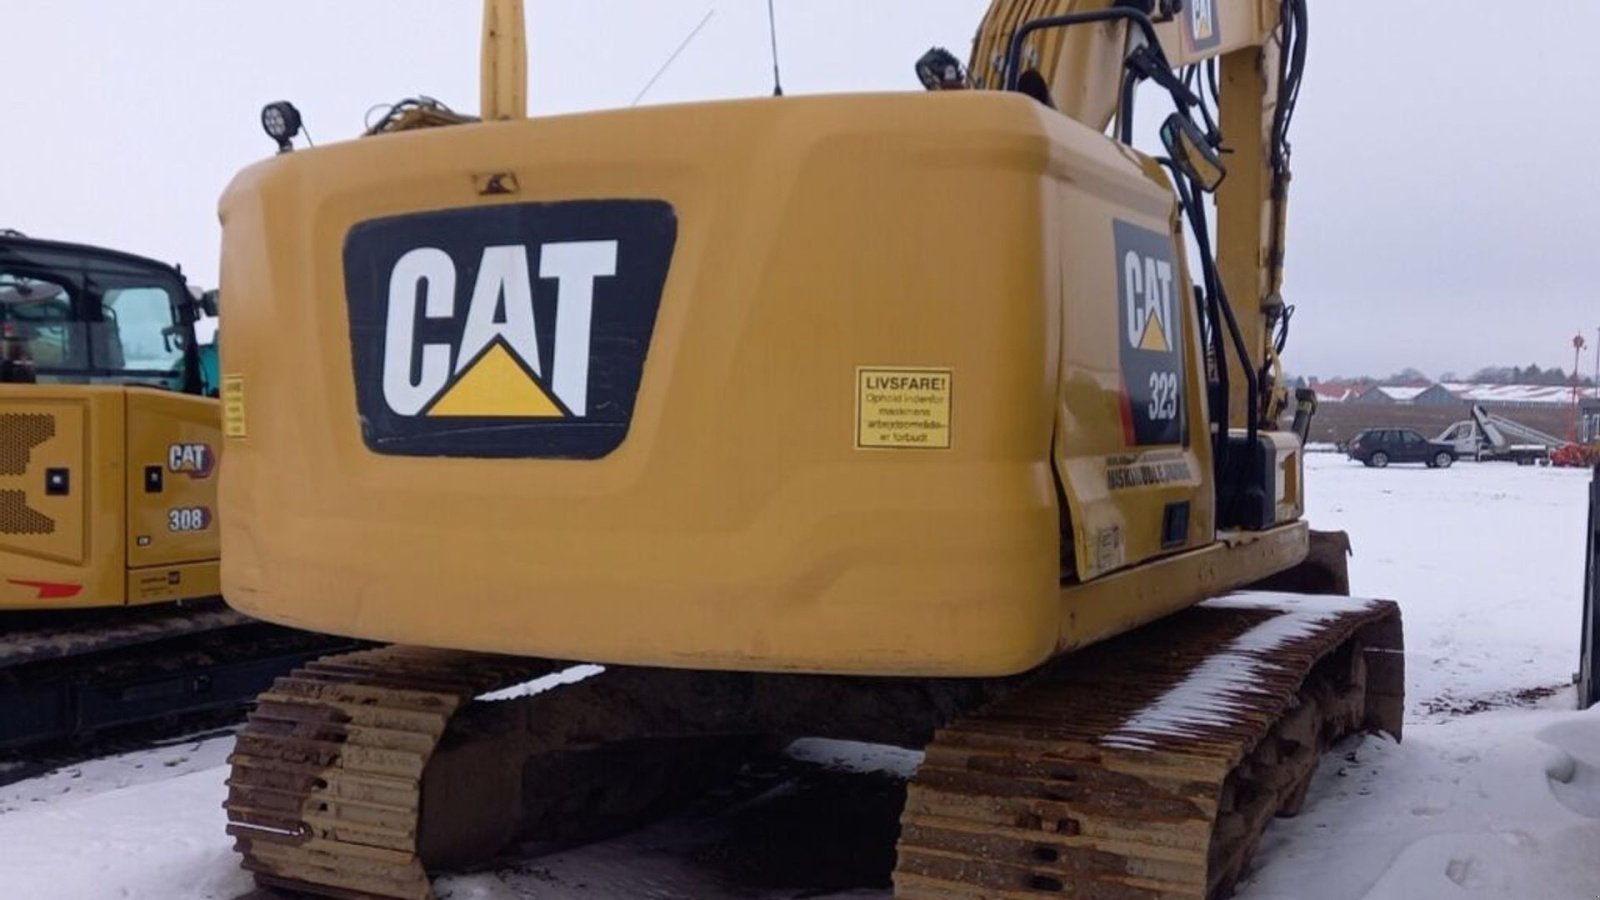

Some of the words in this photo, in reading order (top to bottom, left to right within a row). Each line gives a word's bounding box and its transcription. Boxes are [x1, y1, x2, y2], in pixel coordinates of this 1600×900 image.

[1125, 250, 1173, 353] CAT
[383, 240, 618, 417] CAT
[866, 376, 946, 391] LIVSFARE!
[1149, 371, 1177, 420] 323
[169, 445, 205, 471] CAT
[169, 508, 202, 531] 308
